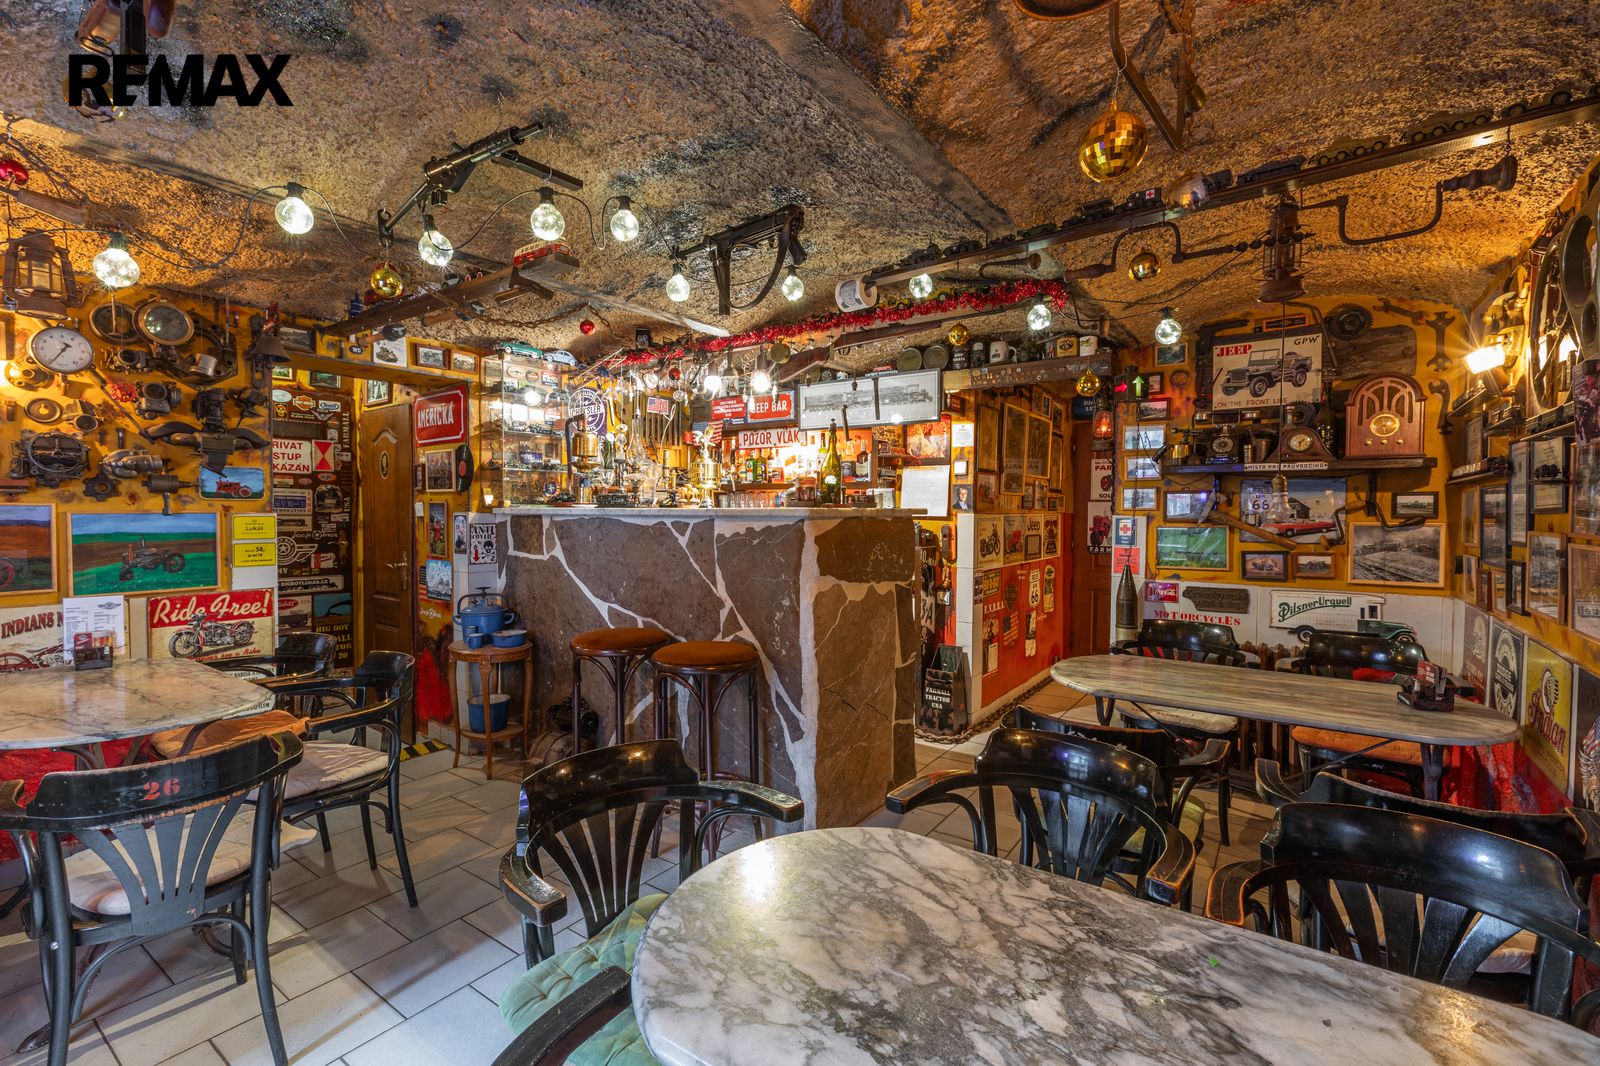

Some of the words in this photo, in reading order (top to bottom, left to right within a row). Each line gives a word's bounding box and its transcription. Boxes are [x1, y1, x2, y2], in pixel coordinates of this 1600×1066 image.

[1294, 335, 1320, 345] GPW
[1216, 344, 1252, 357] JEEP
[771, 400, 788, 412] BAR
[418, 401, 454, 429] AMERICKÁ
[743, 430, 772, 446] POZOR
[777, 429, 800, 443] VLAK
[273, 441, 303, 450] RIVAT
[273, 452, 301, 460] STUP
[1252, 500, 1270, 510] 66
[471, 526, 495, 535] ANTI
[1027, 517, 1040, 533] Jeep
[1031, 590, 1038, 604] 66
[153, 596, 206, 624] Ride
[210, 591, 271, 619] Free!
[1278, 600, 1319, 622] Pilsner
[1319, 596, 1352, 608] Urquell
[1, 612, 54, 639] INDIANS
[925, 686, 951, 696] FARMALL
[925, 694, 950, 703] TRACTOR
[1528, 688, 1567, 756] Indian
[143, 778, 181, 800] 26
